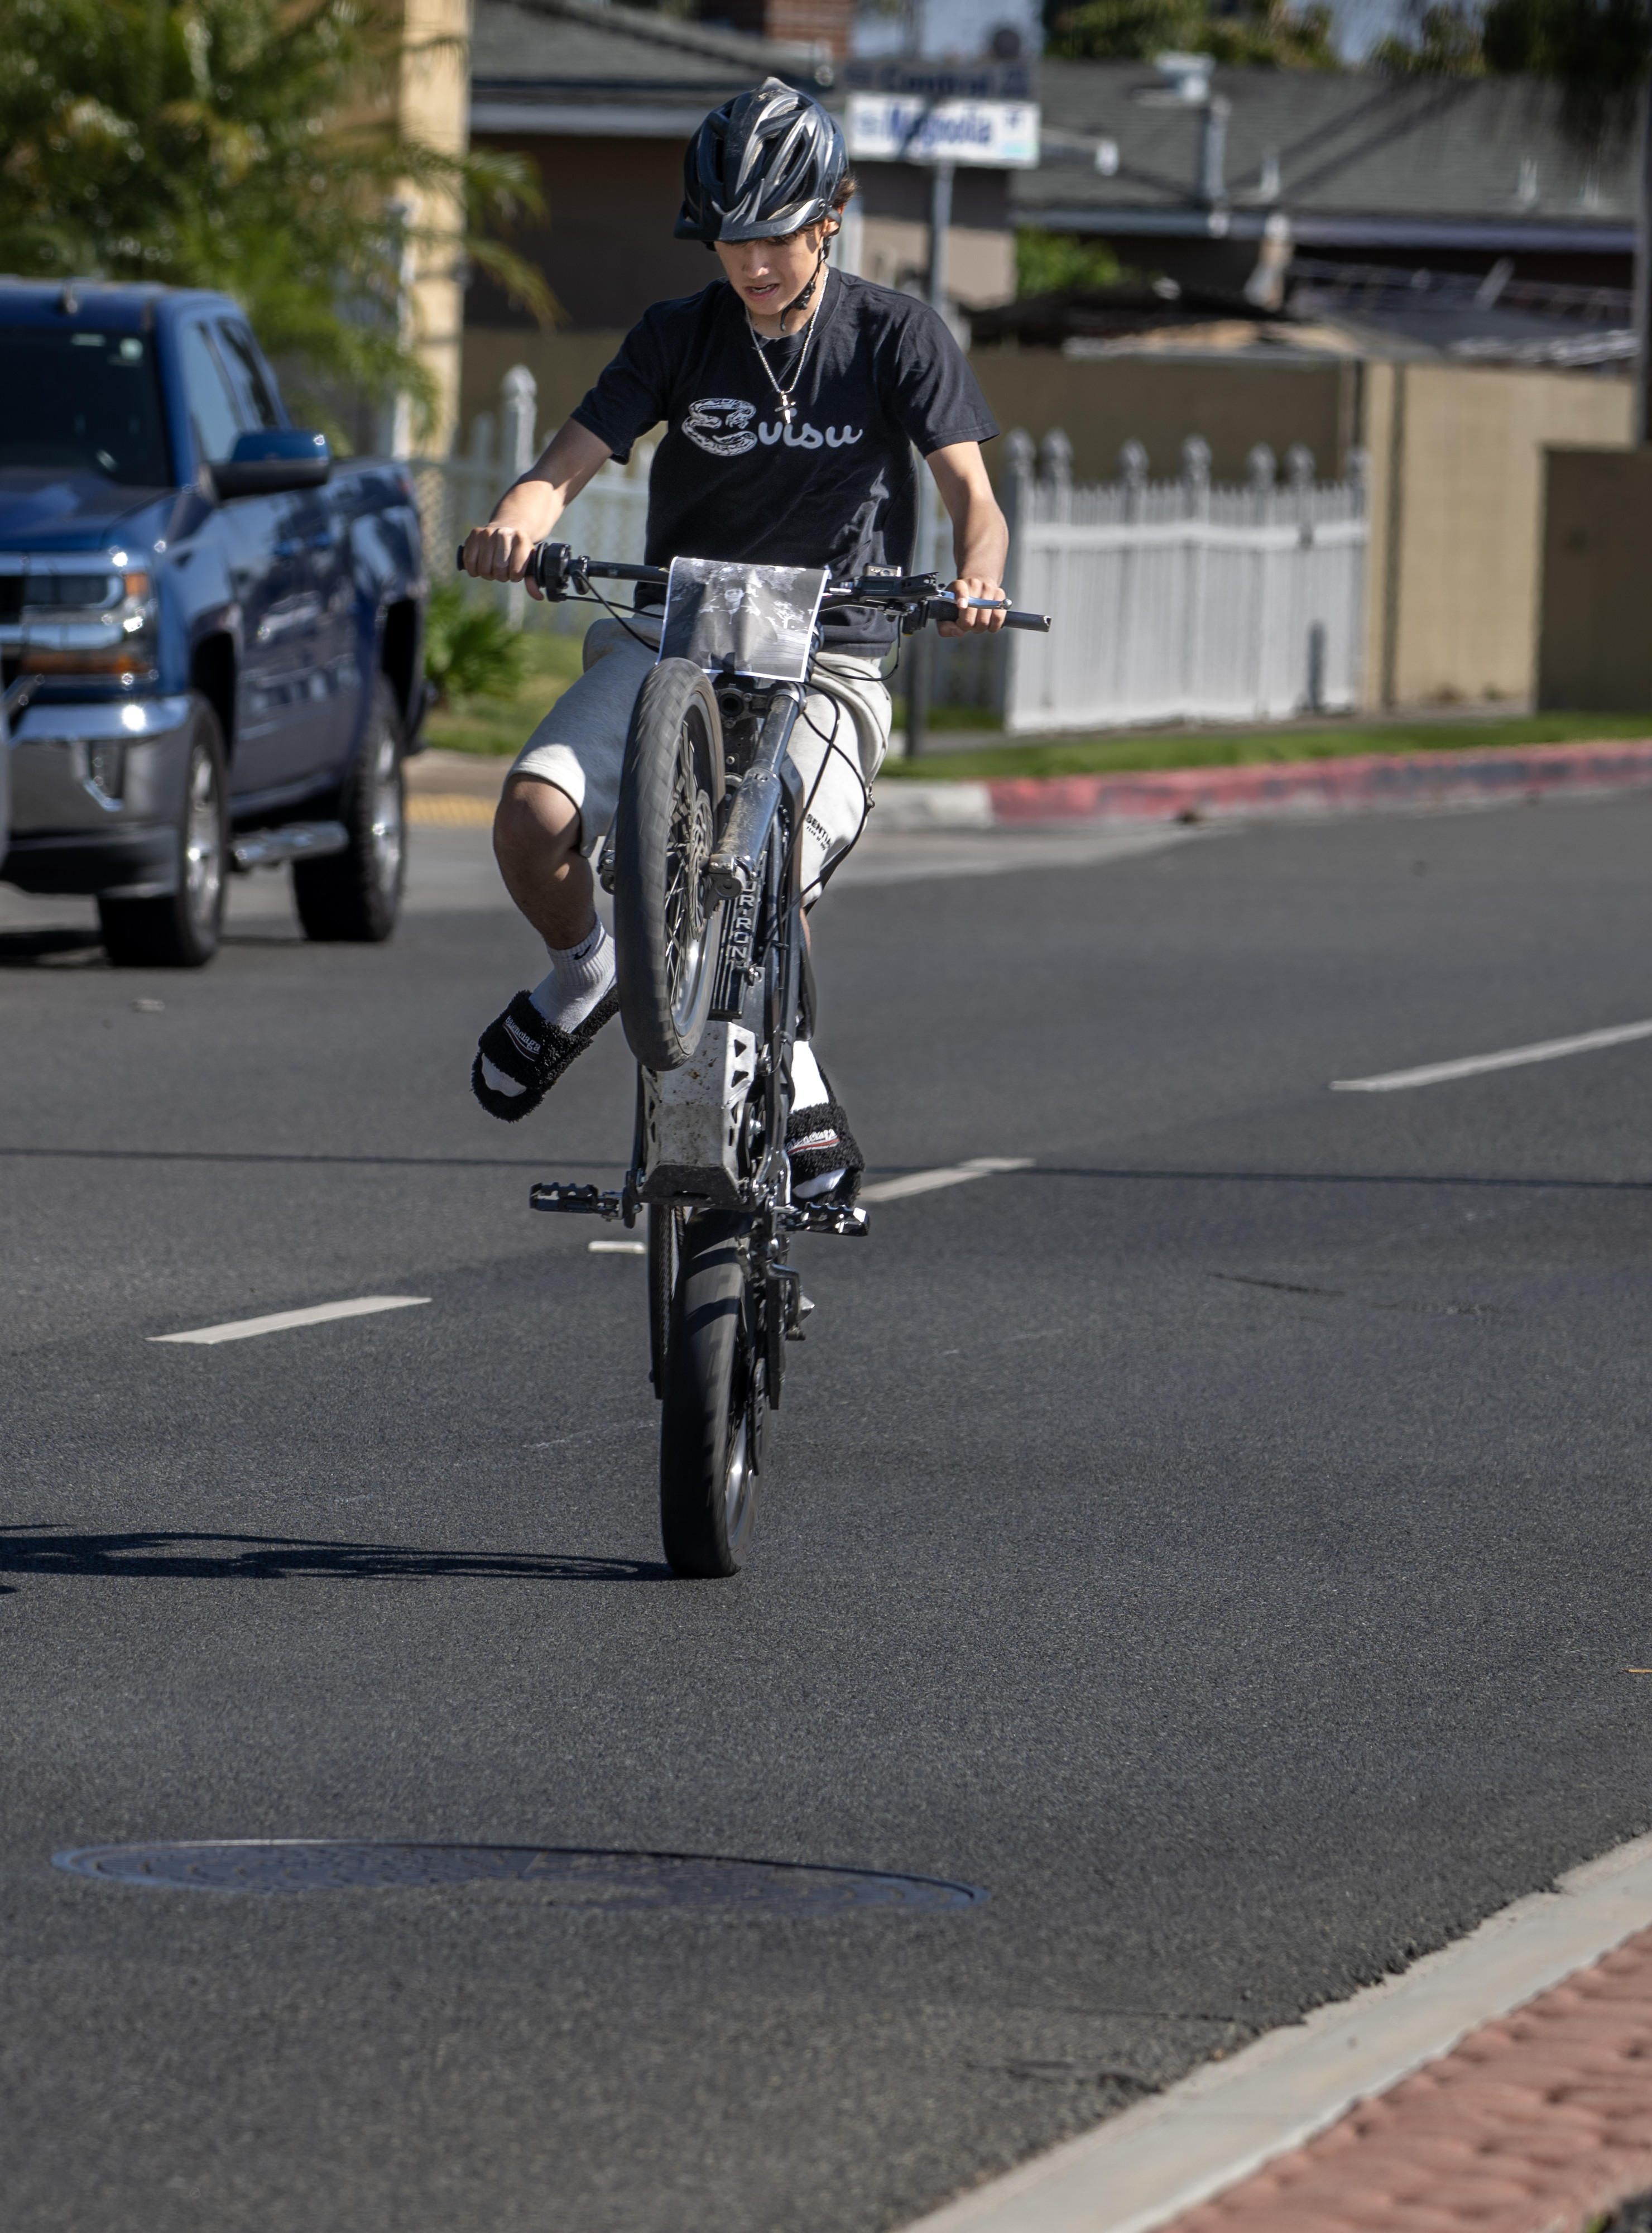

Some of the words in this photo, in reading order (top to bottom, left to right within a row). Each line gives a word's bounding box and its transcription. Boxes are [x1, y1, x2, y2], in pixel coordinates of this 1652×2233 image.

[681, 398, 863, 456] Evisu
[731, 881, 757, 959] UR-RON
[505, 1015, 541, 1052] Balenciaga
[785, 1128, 837, 1151] alenciaga
